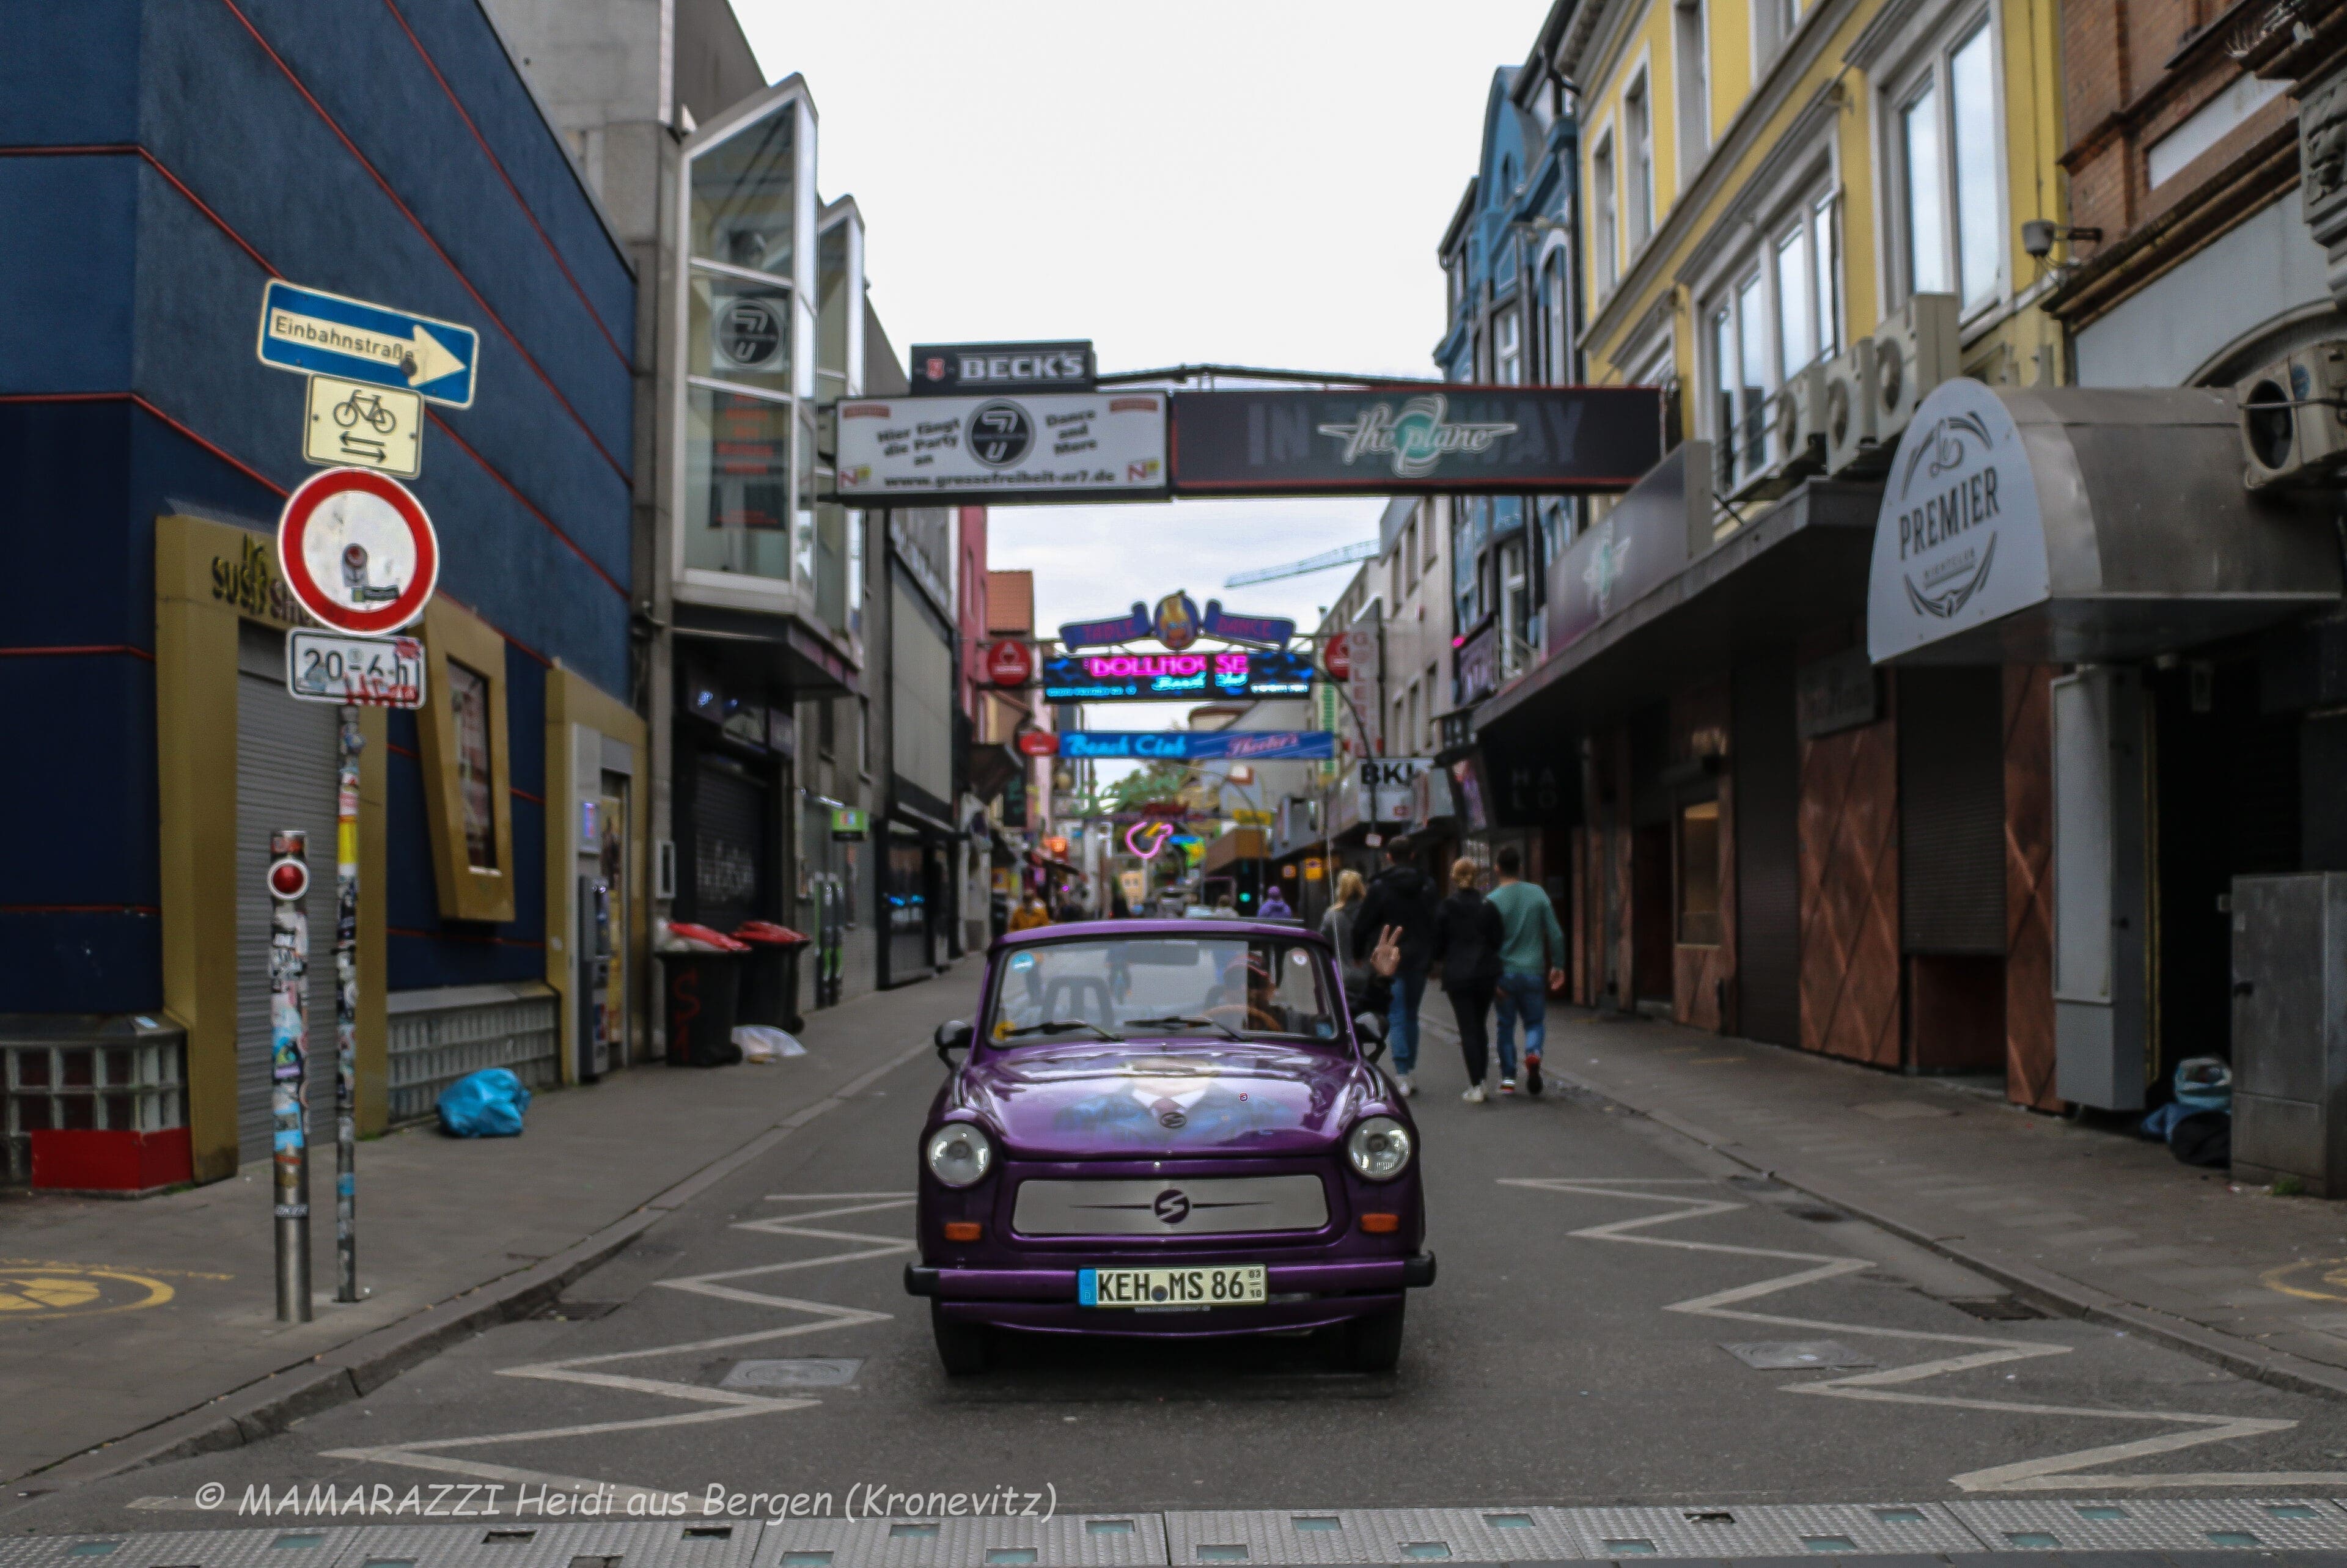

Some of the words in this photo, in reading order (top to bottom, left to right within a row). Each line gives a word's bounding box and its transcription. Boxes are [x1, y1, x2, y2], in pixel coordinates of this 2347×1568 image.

[276, 315, 414, 359] Einbahnstraße
[960, 353, 1085, 379] BECK'S
[915, 435, 958, 451] Party
[1899, 466, 2000, 561] PREMIER
[1098, 1273, 1150, 1302] KEH
[1169, 1271, 1204, 1301] MS
[1211, 1270, 1244, 1300] 86
